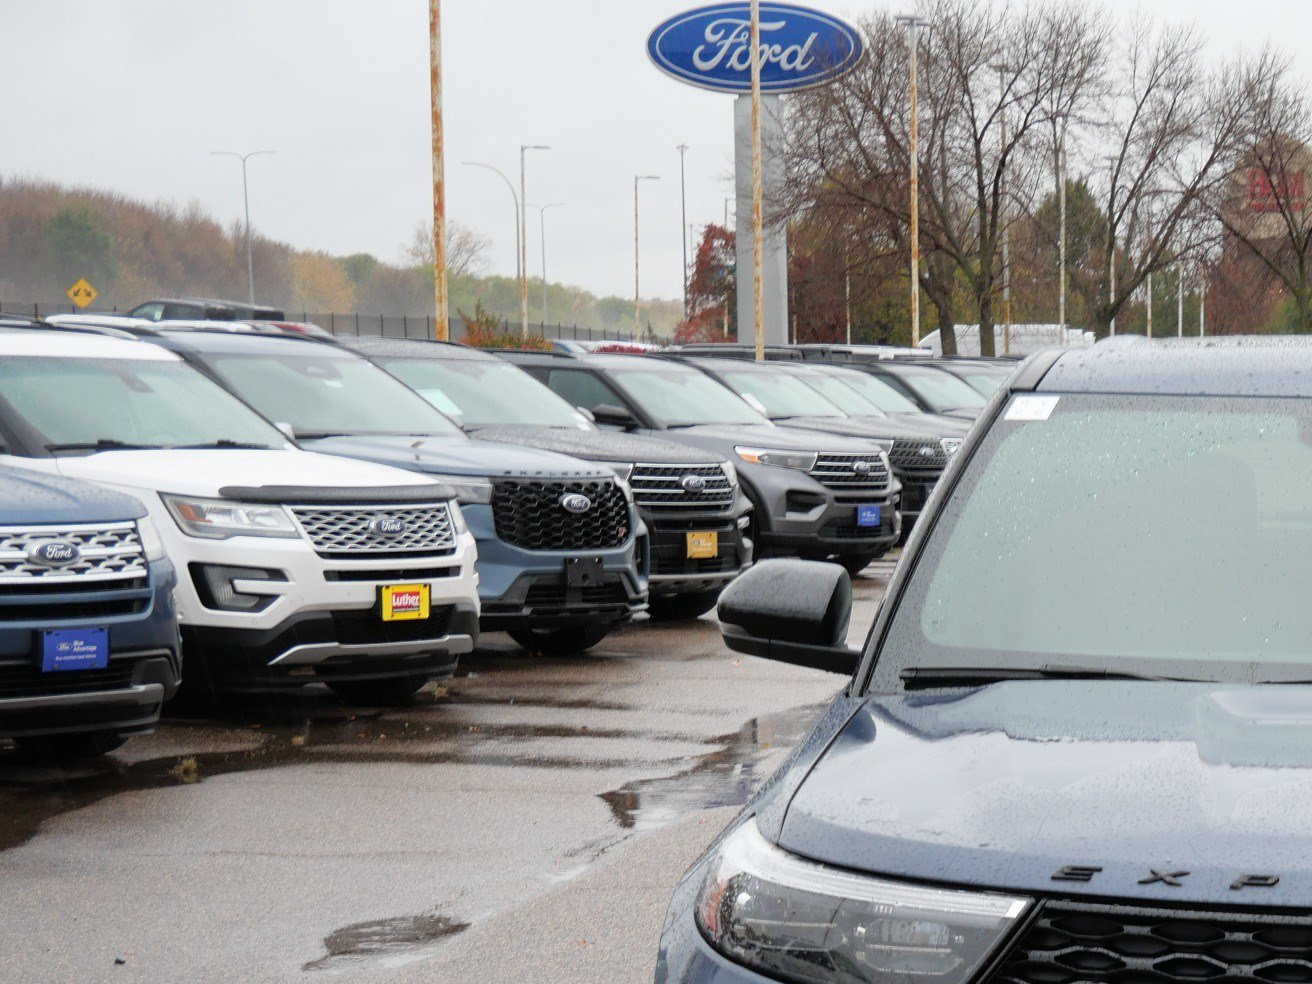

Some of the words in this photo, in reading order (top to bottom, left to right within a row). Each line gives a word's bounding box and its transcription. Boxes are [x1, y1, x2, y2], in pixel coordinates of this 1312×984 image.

[692, 18, 819, 72] Ford
[46, 543, 73, 559] Ford
[392, 593, 420, 607] Luther
